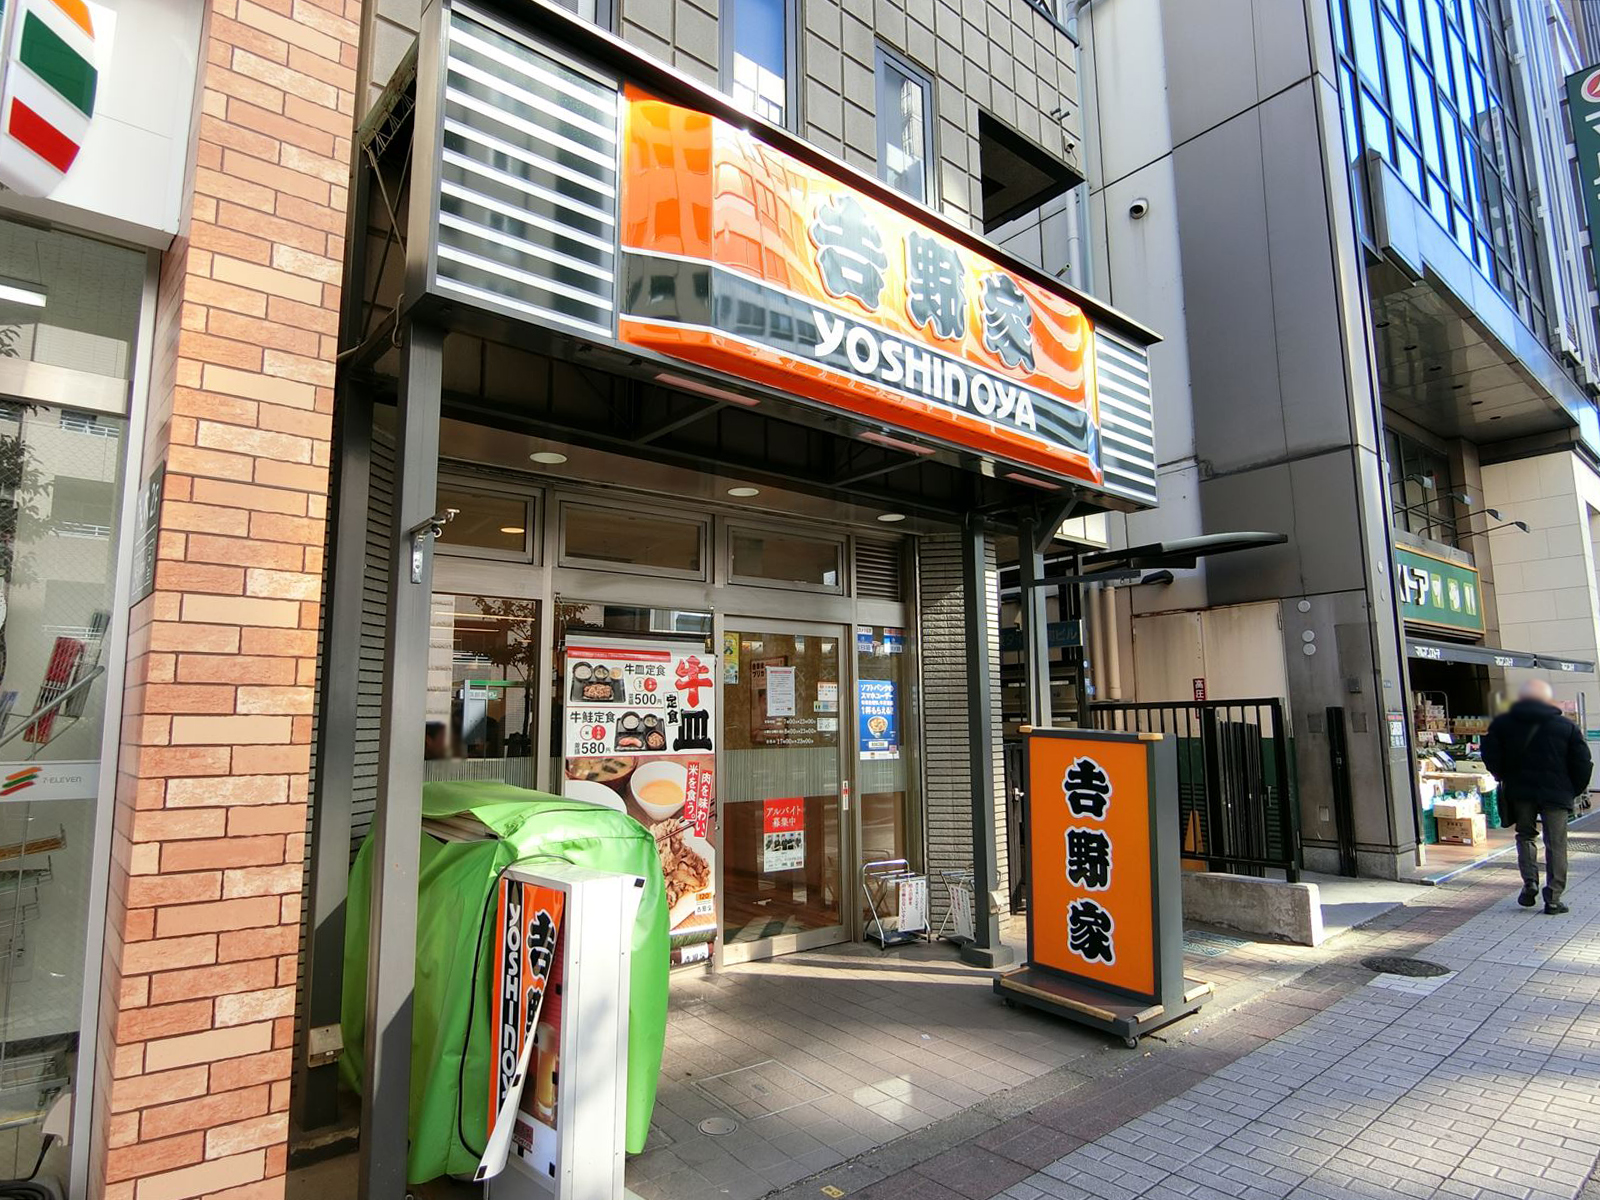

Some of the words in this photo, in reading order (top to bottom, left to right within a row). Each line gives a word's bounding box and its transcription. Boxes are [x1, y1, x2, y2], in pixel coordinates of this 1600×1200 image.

[809, 194, 1037, 375] 吉野家
[813, 310, 1038, 431] YOSHINOYA
[624, 663, 666, 677] 牛皿定食
[569, 710, 616, 724] 牛鮭定食
[665, 694, 679, 725] 定食
[686, 764, 698, 819] 米を食う。
[765, 806, 801, 817] アルバイト
[772, 817, 796, 827] 募集中
[1062, 756, 1116, 966] 吉野家
